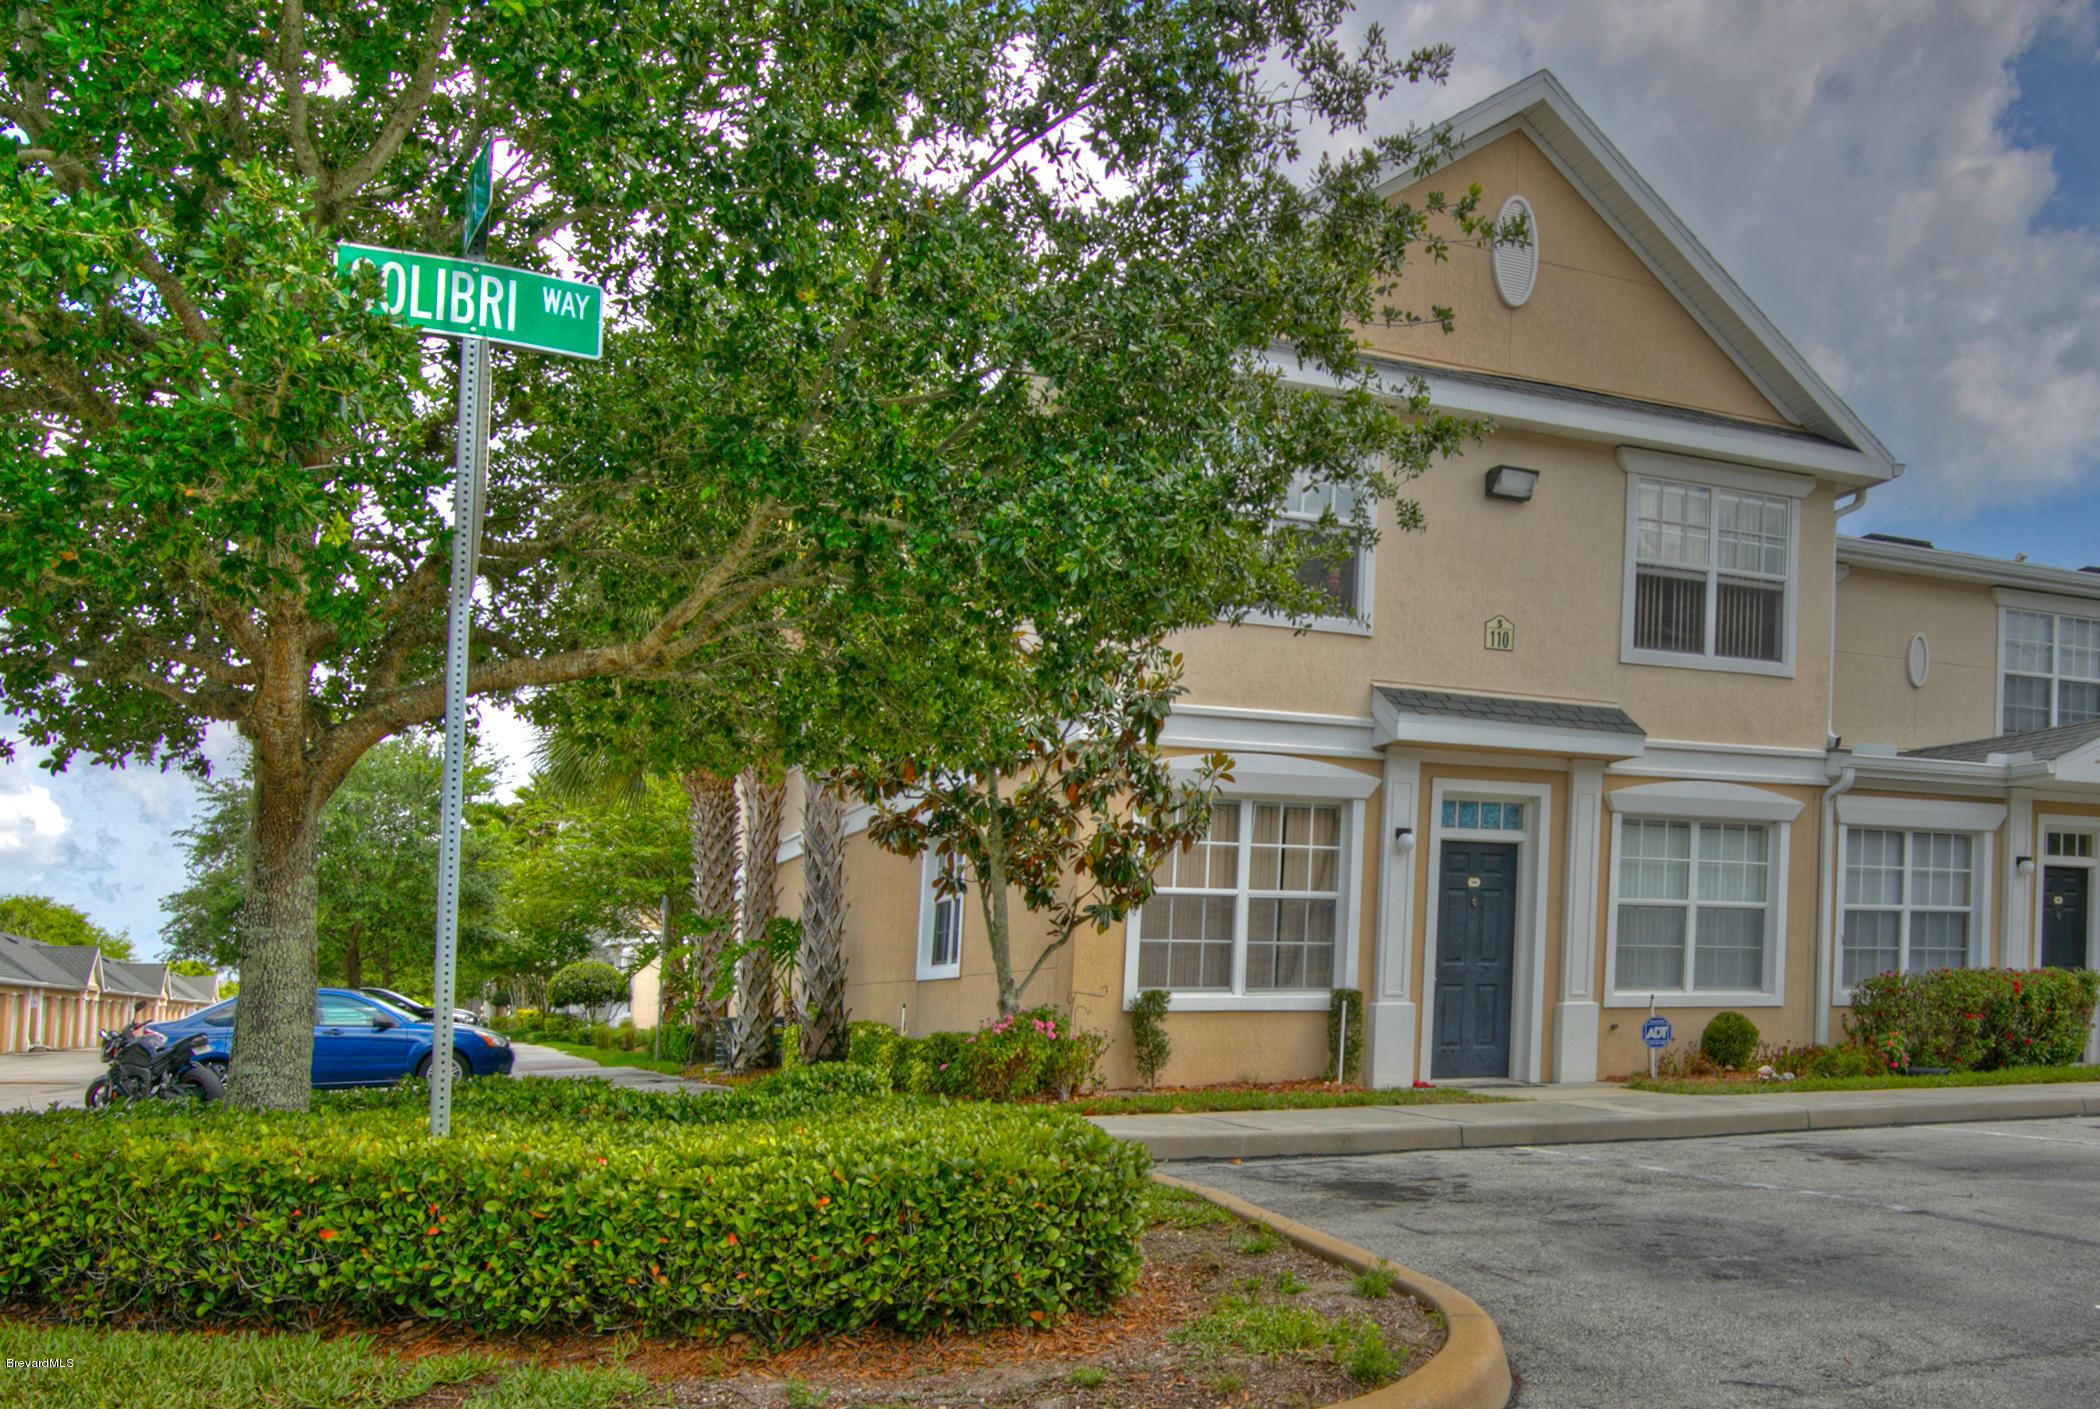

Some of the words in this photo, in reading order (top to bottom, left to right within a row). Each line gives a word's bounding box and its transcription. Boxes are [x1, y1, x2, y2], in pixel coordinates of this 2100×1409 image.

[542, 285, 590, 320] WAY
[1490, 630, 1510, 649] 110
[1645, 1026, 1669, 1040] ADT
